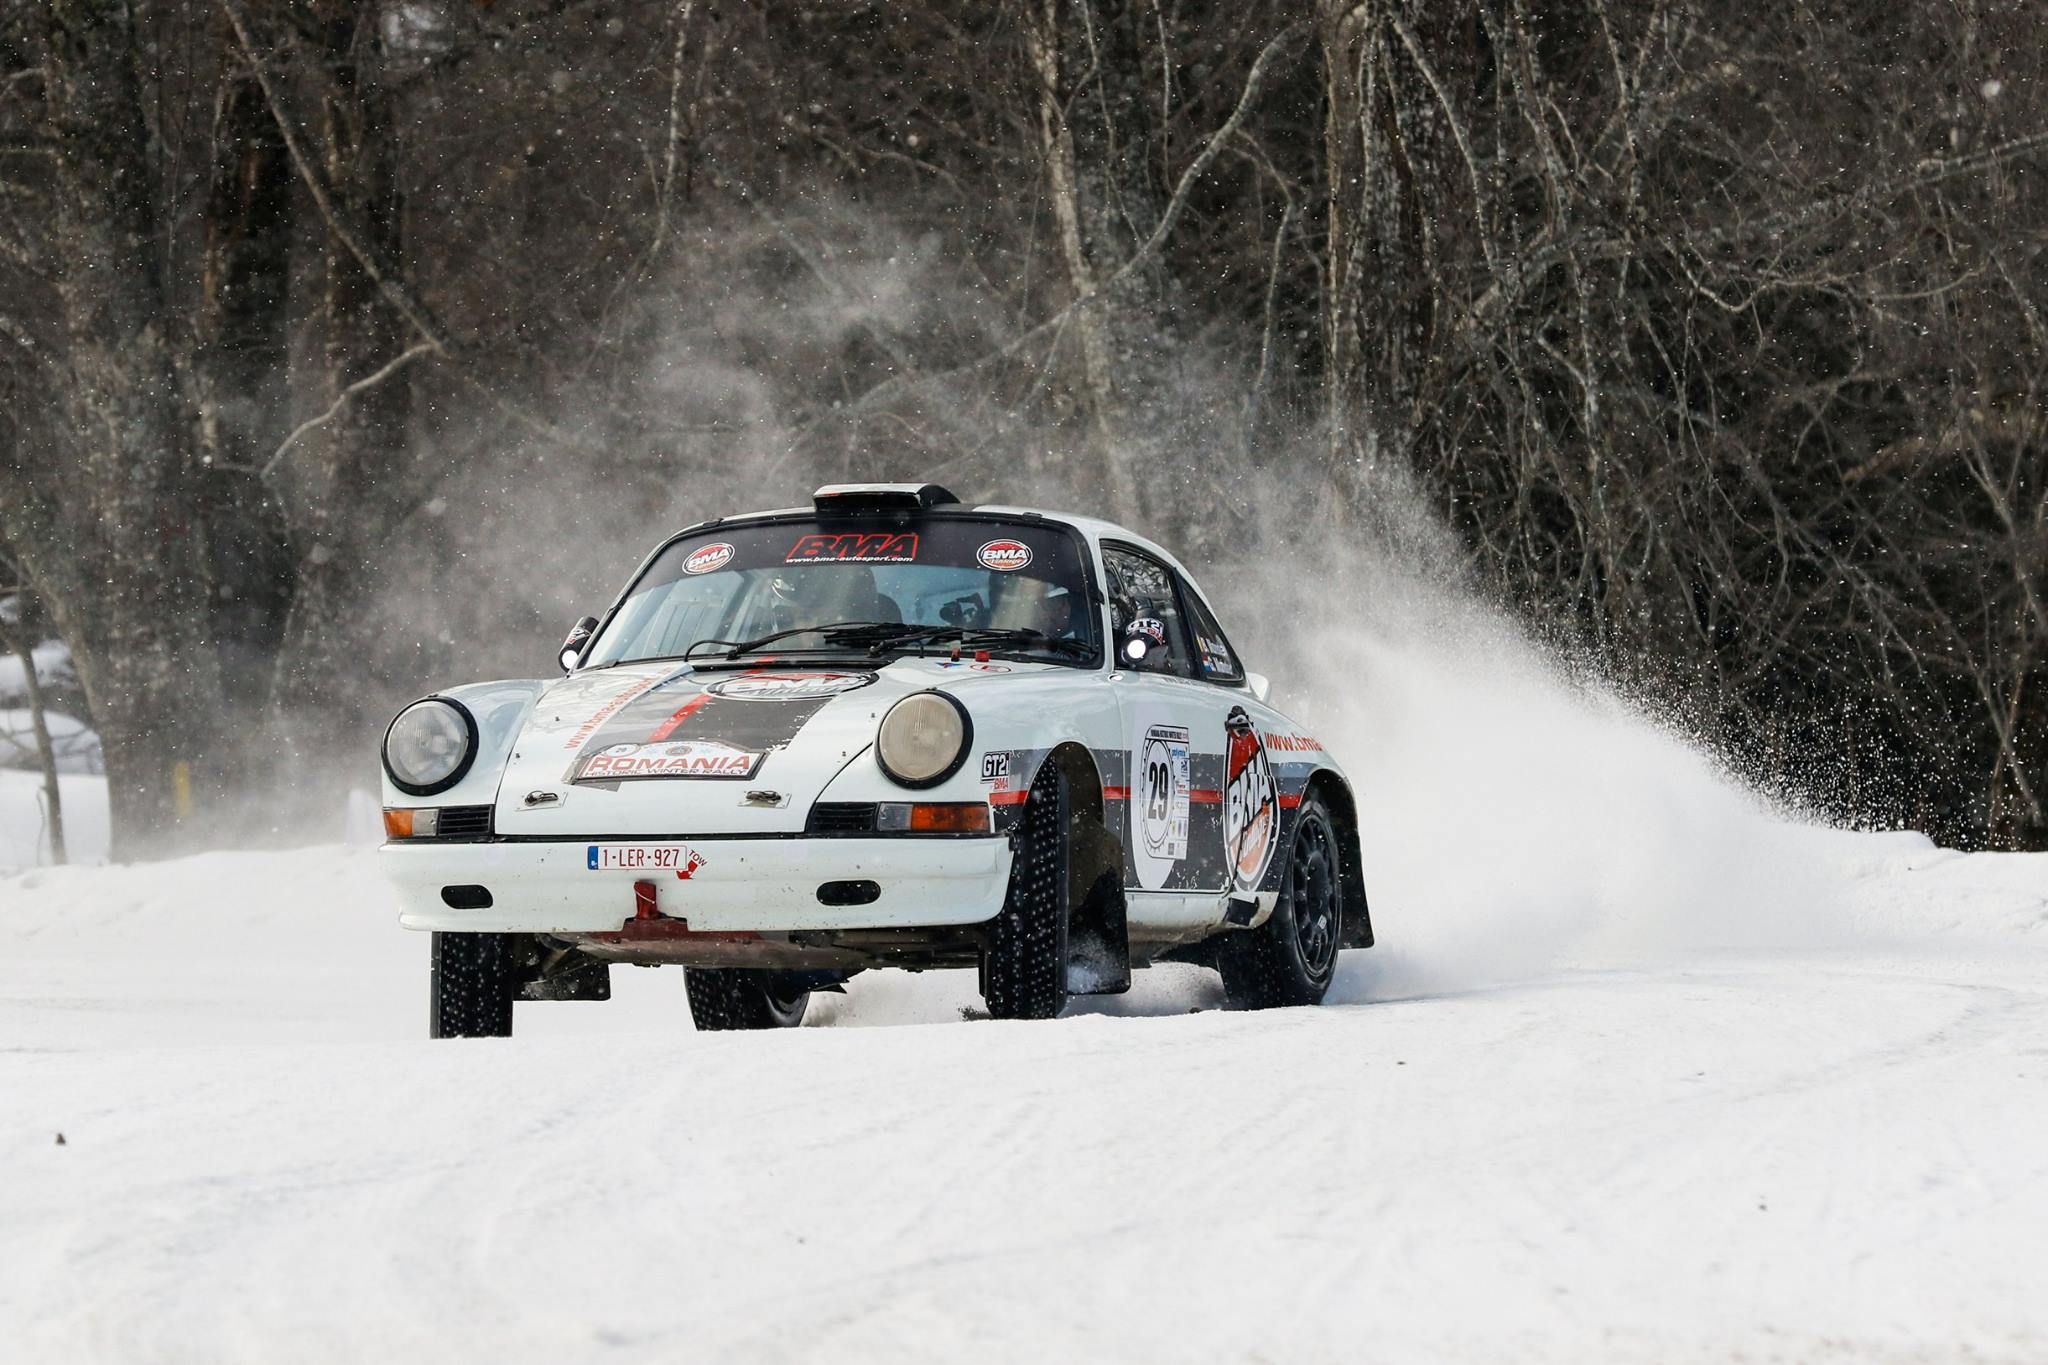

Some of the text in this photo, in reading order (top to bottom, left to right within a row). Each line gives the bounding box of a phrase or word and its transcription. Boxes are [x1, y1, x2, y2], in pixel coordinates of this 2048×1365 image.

[786, 534, 918, 560] BMA
[982, 549, 1027, 560] BMA
[687, 548, 729, 568] BMA
[722, 677, 863, 694] BMA
[589, 756, 750, 771] ROMANIA
[585, 769, 640, 777] HISTORIC
[1148, 761, 1169, 821] 29
[1229, 750, 1271, 841] BMA
[688, 849, 708, 867] TOW
